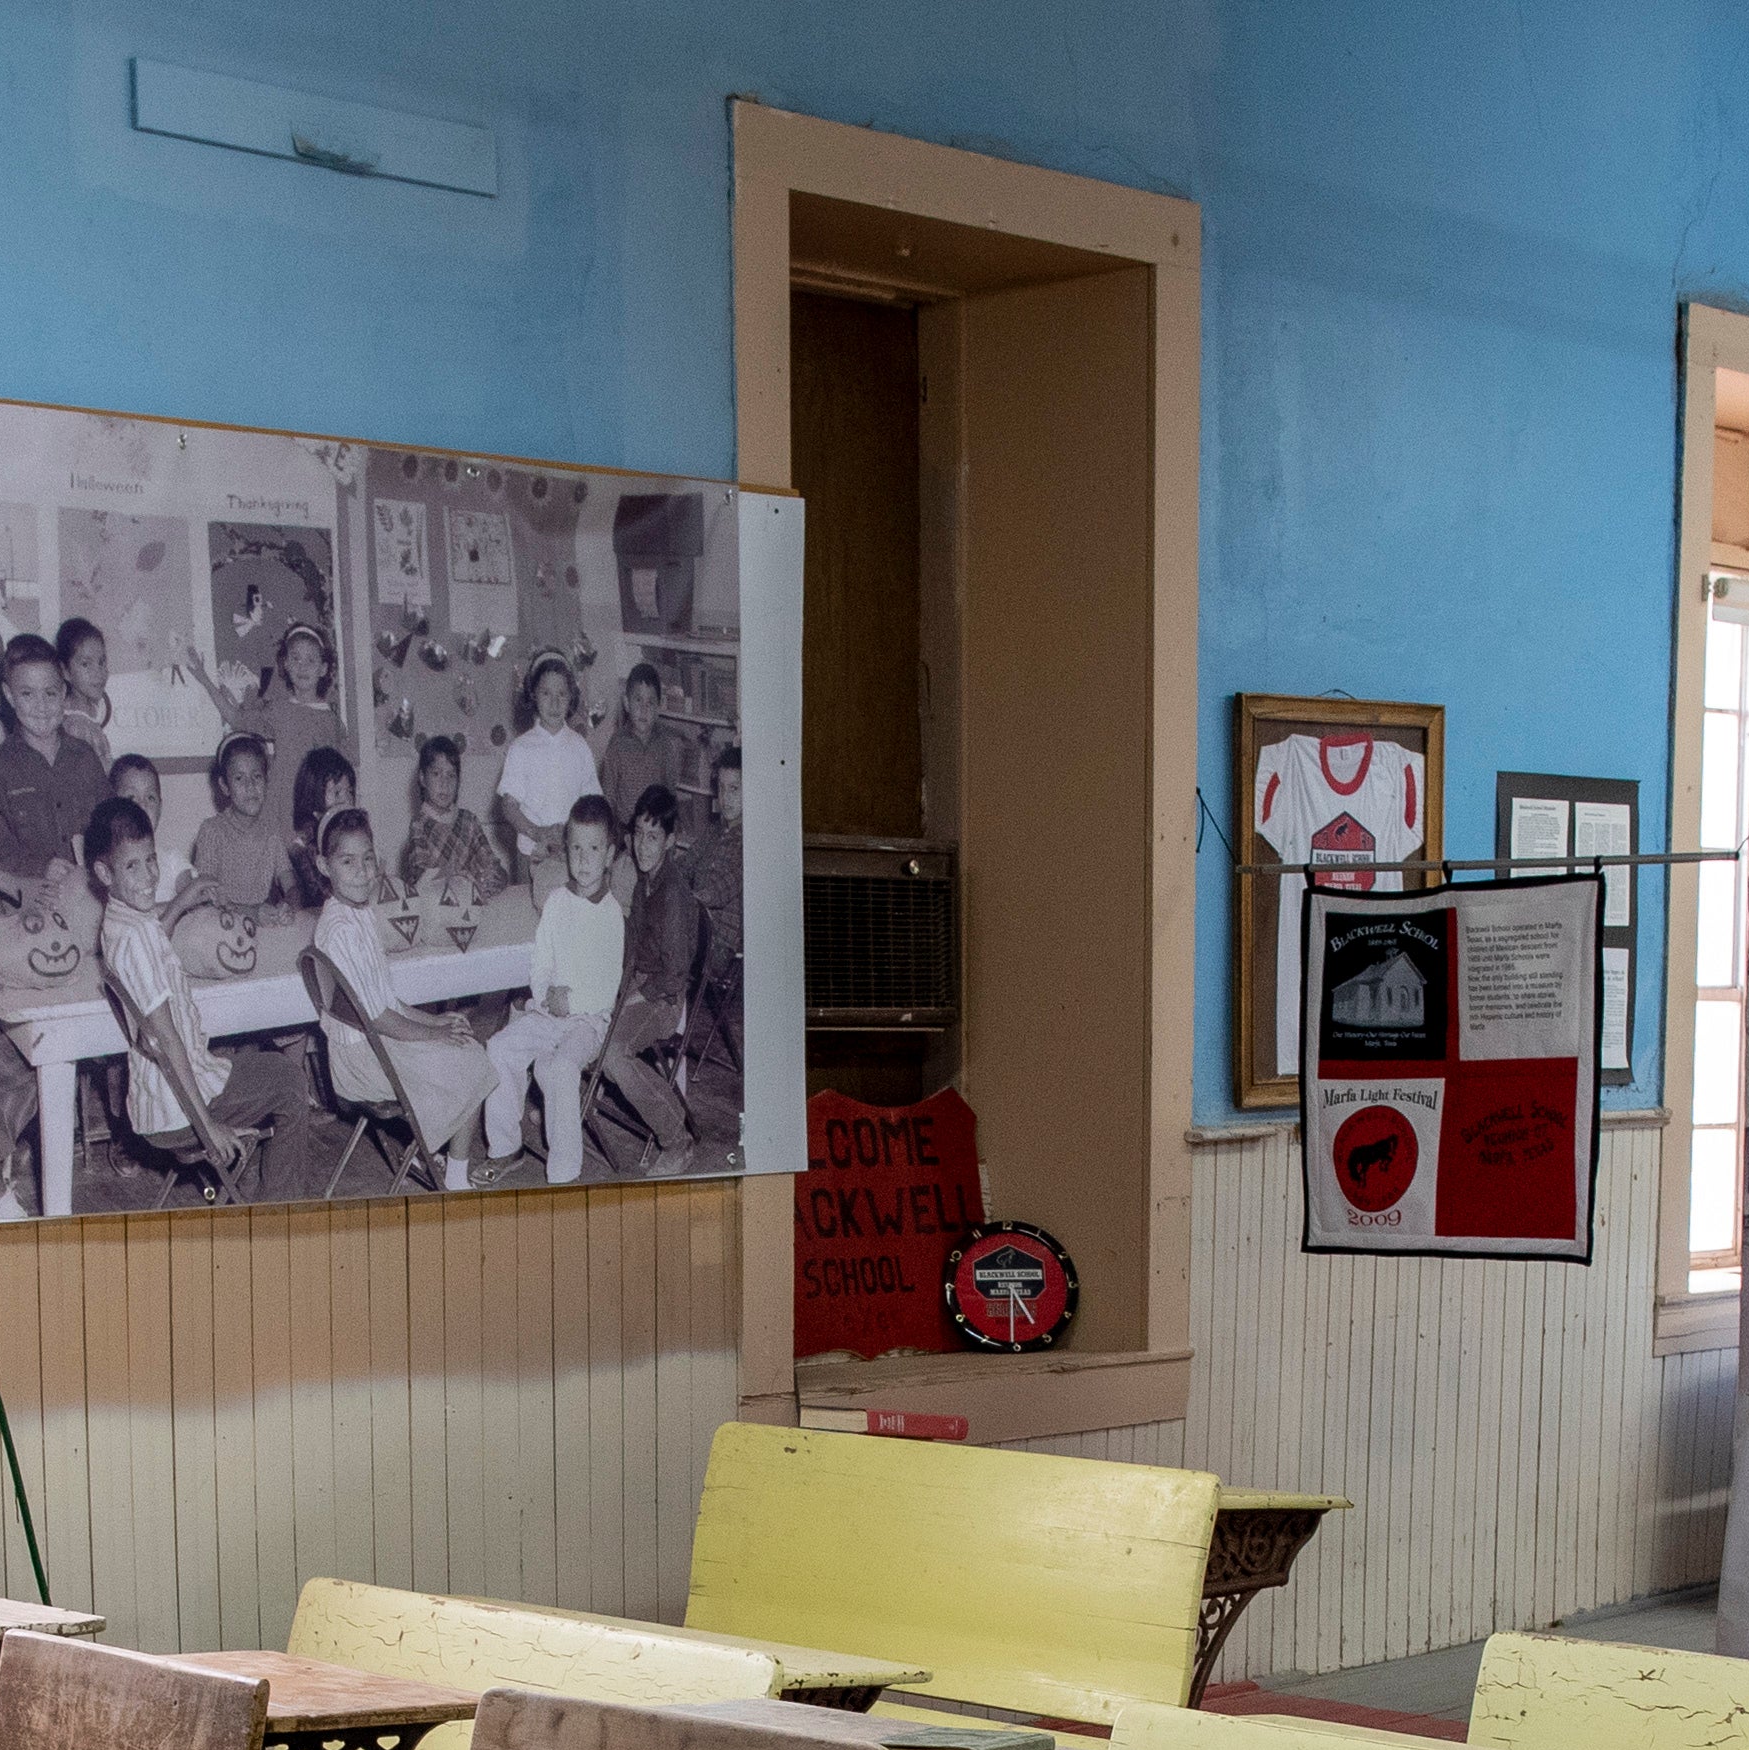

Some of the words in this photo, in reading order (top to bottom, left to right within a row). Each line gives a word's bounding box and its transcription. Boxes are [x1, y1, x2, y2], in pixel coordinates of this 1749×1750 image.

[69, 471, 144, 494] Halloween
[1512, 924, 1537, 932] operated
[1329, 923, 1396, 952] BLACKWELL
[1399, 920, 1439, 950] SCHOOL
[1322, 1087, 1357, 1109] Marfa
[1360, 1088, 1389, 1103] Light
[1392, 1087, 1439, 1110] Festival
[809, 1115, 940, 1169] COME
[1346, 1208, 1402, 1226] 2009
[1002, 1220, 1013, 1231] 12
[949, 1250, 962, 1263] 10
[803, 1255, 916, 1299] SCHOOL
[979, 1270, 1015, 1279] BLACKWELL
[1016, 1270, 1041, 1279] SCHOOL
[1041, 1332, 1053, 1344] 5
[1012, 1342, 1022, 1353] 6
